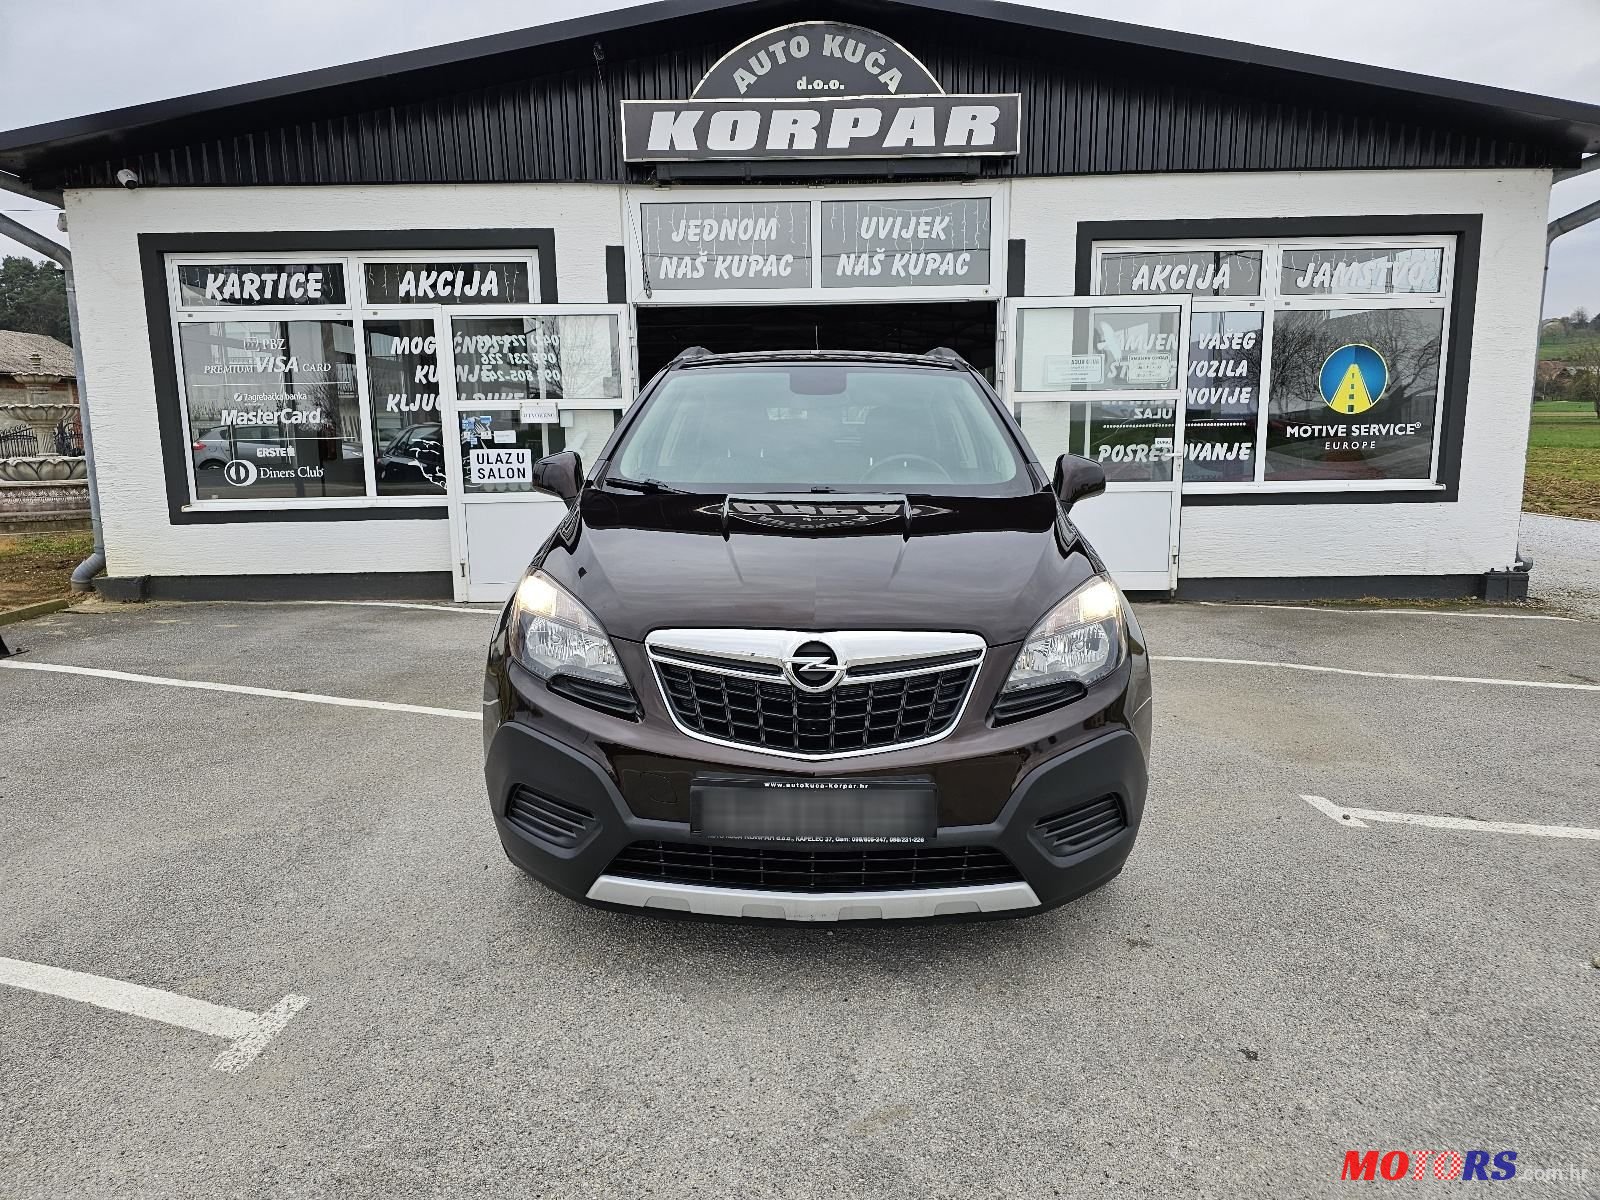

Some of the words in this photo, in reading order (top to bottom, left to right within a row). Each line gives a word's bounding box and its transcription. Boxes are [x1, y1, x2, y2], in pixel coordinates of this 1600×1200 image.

[732, 35, 810, 95] AUTO
[822, 34, 903, 95] KUĆA
[796, 76, 845, 90] d.o.o.
[646, 105, 1001, 151] KORPAR
[671, 217, 778, 243] JEDNOM
[860, 215, 950, 241] UVIJEK
[659, 250, 708, 279] NAŠ
[714, 252, 794, 280] KUPAC
[835, 247, 886, 277] NAŠ
[891, 251, 971, 277] KUPAC
[399, 270, 499, 299] AKCIJA
[1131, 262, 1231, 292] AKCIJA
[1296, 261, 1427, 289] JAMSTVO
[205, 272, 323, 301] KARTICE
[262, 338, 287, 350] PBZ
[1198, 328, 1257, 351] VAŠEG
[203, 364, 253, 374] PREMIUM
[253, 356, 299, 373] VISA
[302, 363, 332, 372] CARD
[1187, 387, 1252, 405] NOVIJE
[220, 407, 321, 426] MasterCard
[1285, 424, 1347, 438] MOTIVE
[256, 447, 286, 458] ERSTE
[1324, 440, 1376, 450] EUROPE
[476, 452, 512, 465] ULAZ
[516, 452, 525, 464] U
[260, 466, 295, 479] Diners
[297, 465, 324, 478] Club
[477, 467, 526, 480] SALON
[763, 781, 869, 790] www.autokuca-korpar.hr
